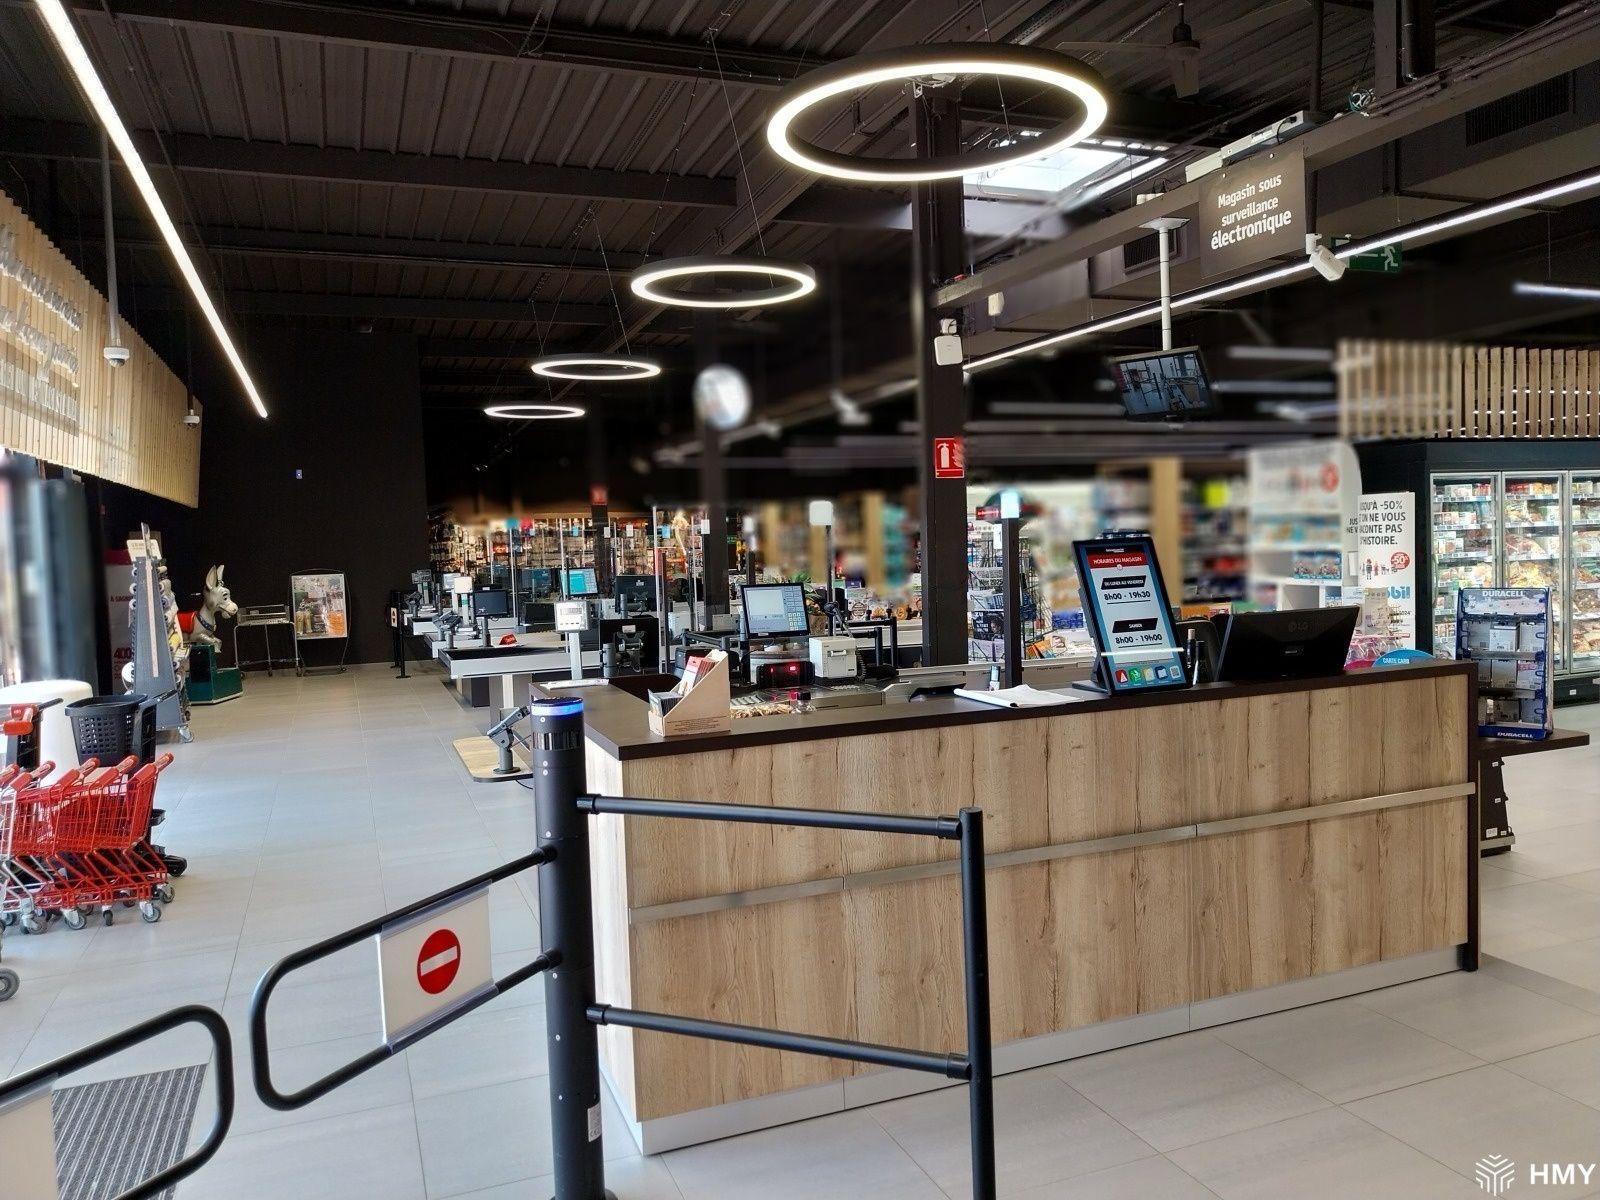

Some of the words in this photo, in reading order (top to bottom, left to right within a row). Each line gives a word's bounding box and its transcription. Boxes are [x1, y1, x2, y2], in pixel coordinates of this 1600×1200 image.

[1218, 184, 1255, 208] Magasin
[1258, 174, 1282, 192] sous
[1221, 196, 1279, 227] surveillance
[1210, 209, 1292, 250] électronique
[1380, 500, 1403, 510] -50%
[1369, 513, 1379, 522] NE
[1381, 512, 1406, 522] VOUS
[1385, 523, 1403, 533] PAS
[1103, 593, 1122, 601] 8h00
[1128, 591, 1151, 599] 19h30
[1115, 636, 1134, 644] 8h00
[1140, 633, 1163, 642] 19h00
